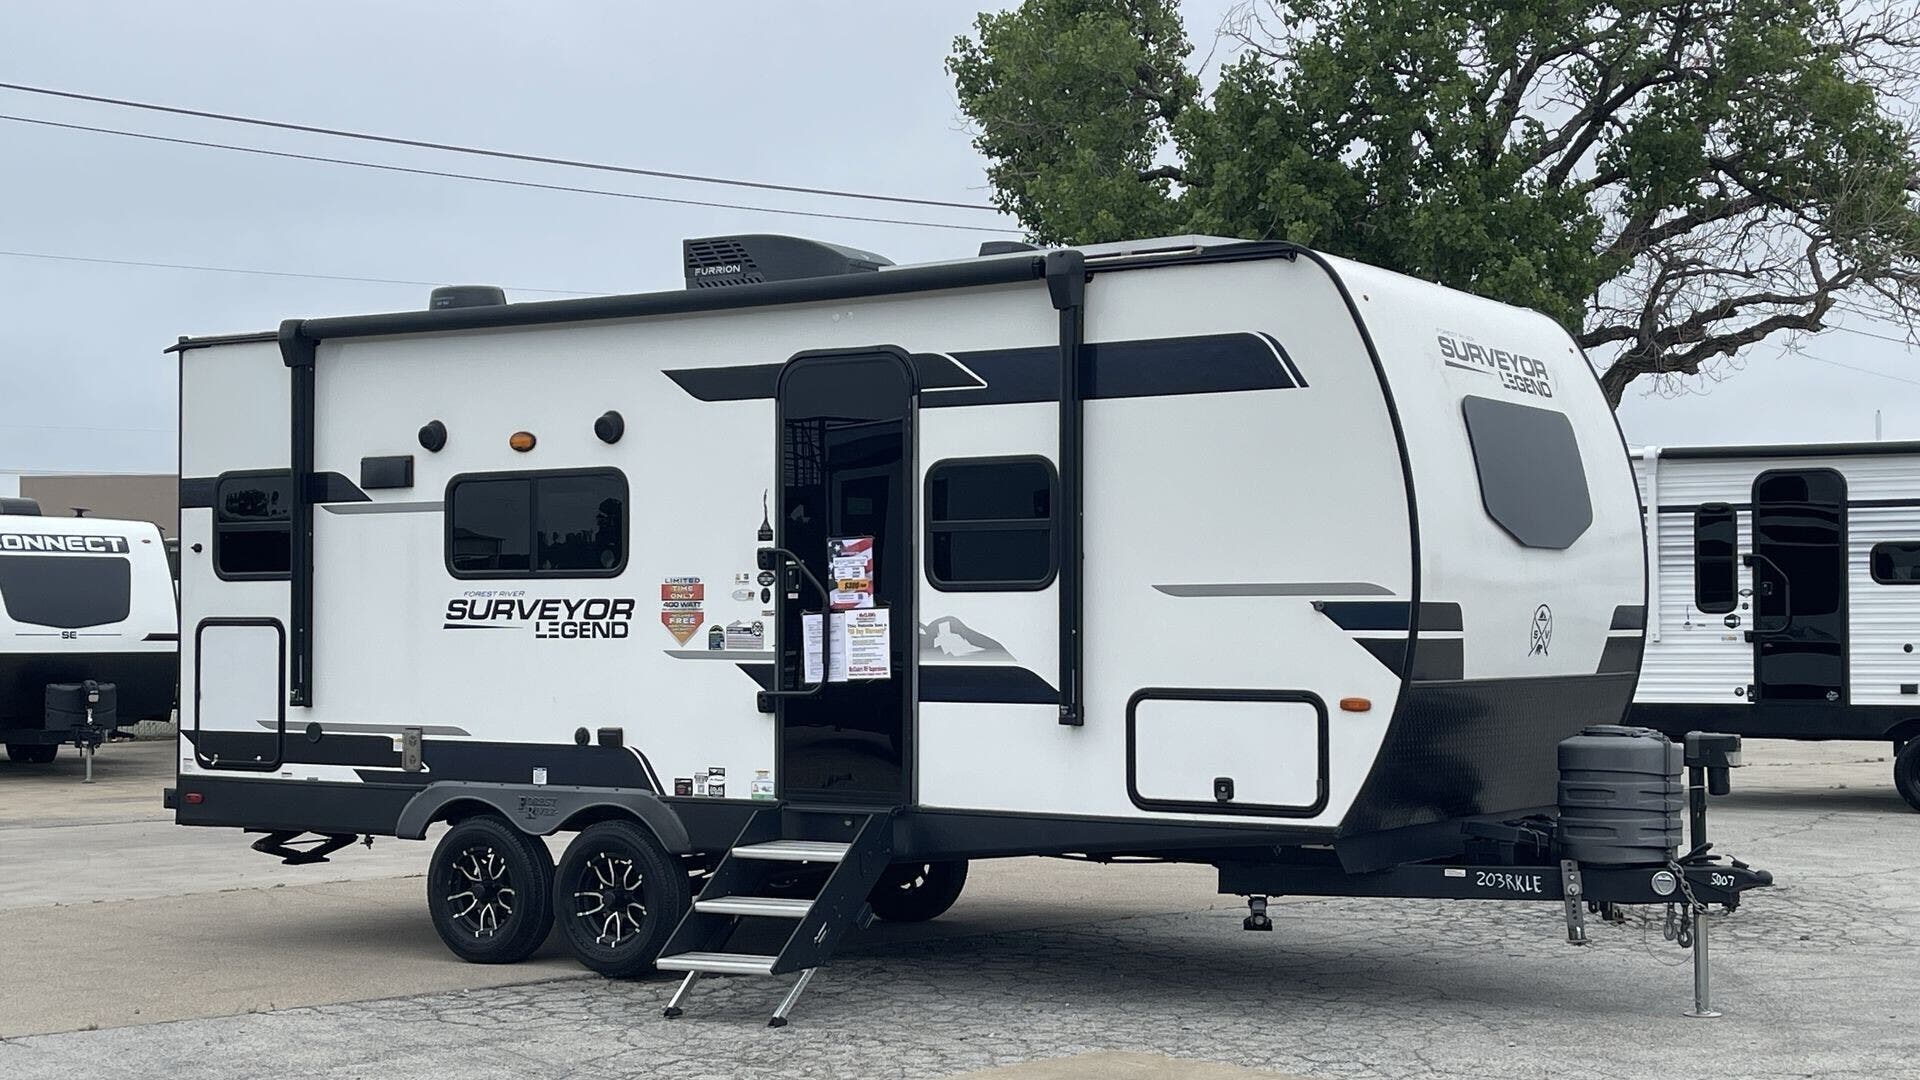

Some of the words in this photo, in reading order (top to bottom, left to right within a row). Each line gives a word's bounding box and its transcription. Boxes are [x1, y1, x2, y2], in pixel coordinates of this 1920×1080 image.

[694, 264, 741, 276] FURRION
[1437, 335, 1549, 380] SURVEYOR
[1498, 371, 1553, 398] LEGEND
[0, 534, 123, 552] ONNECT
[445, 599, 636, 620] SURVEYOR
[61, 630, 77, 639] SE
[535, 621, 629, 639] LEGEND
[1476, 871, 1542, 893] 203RKLE
